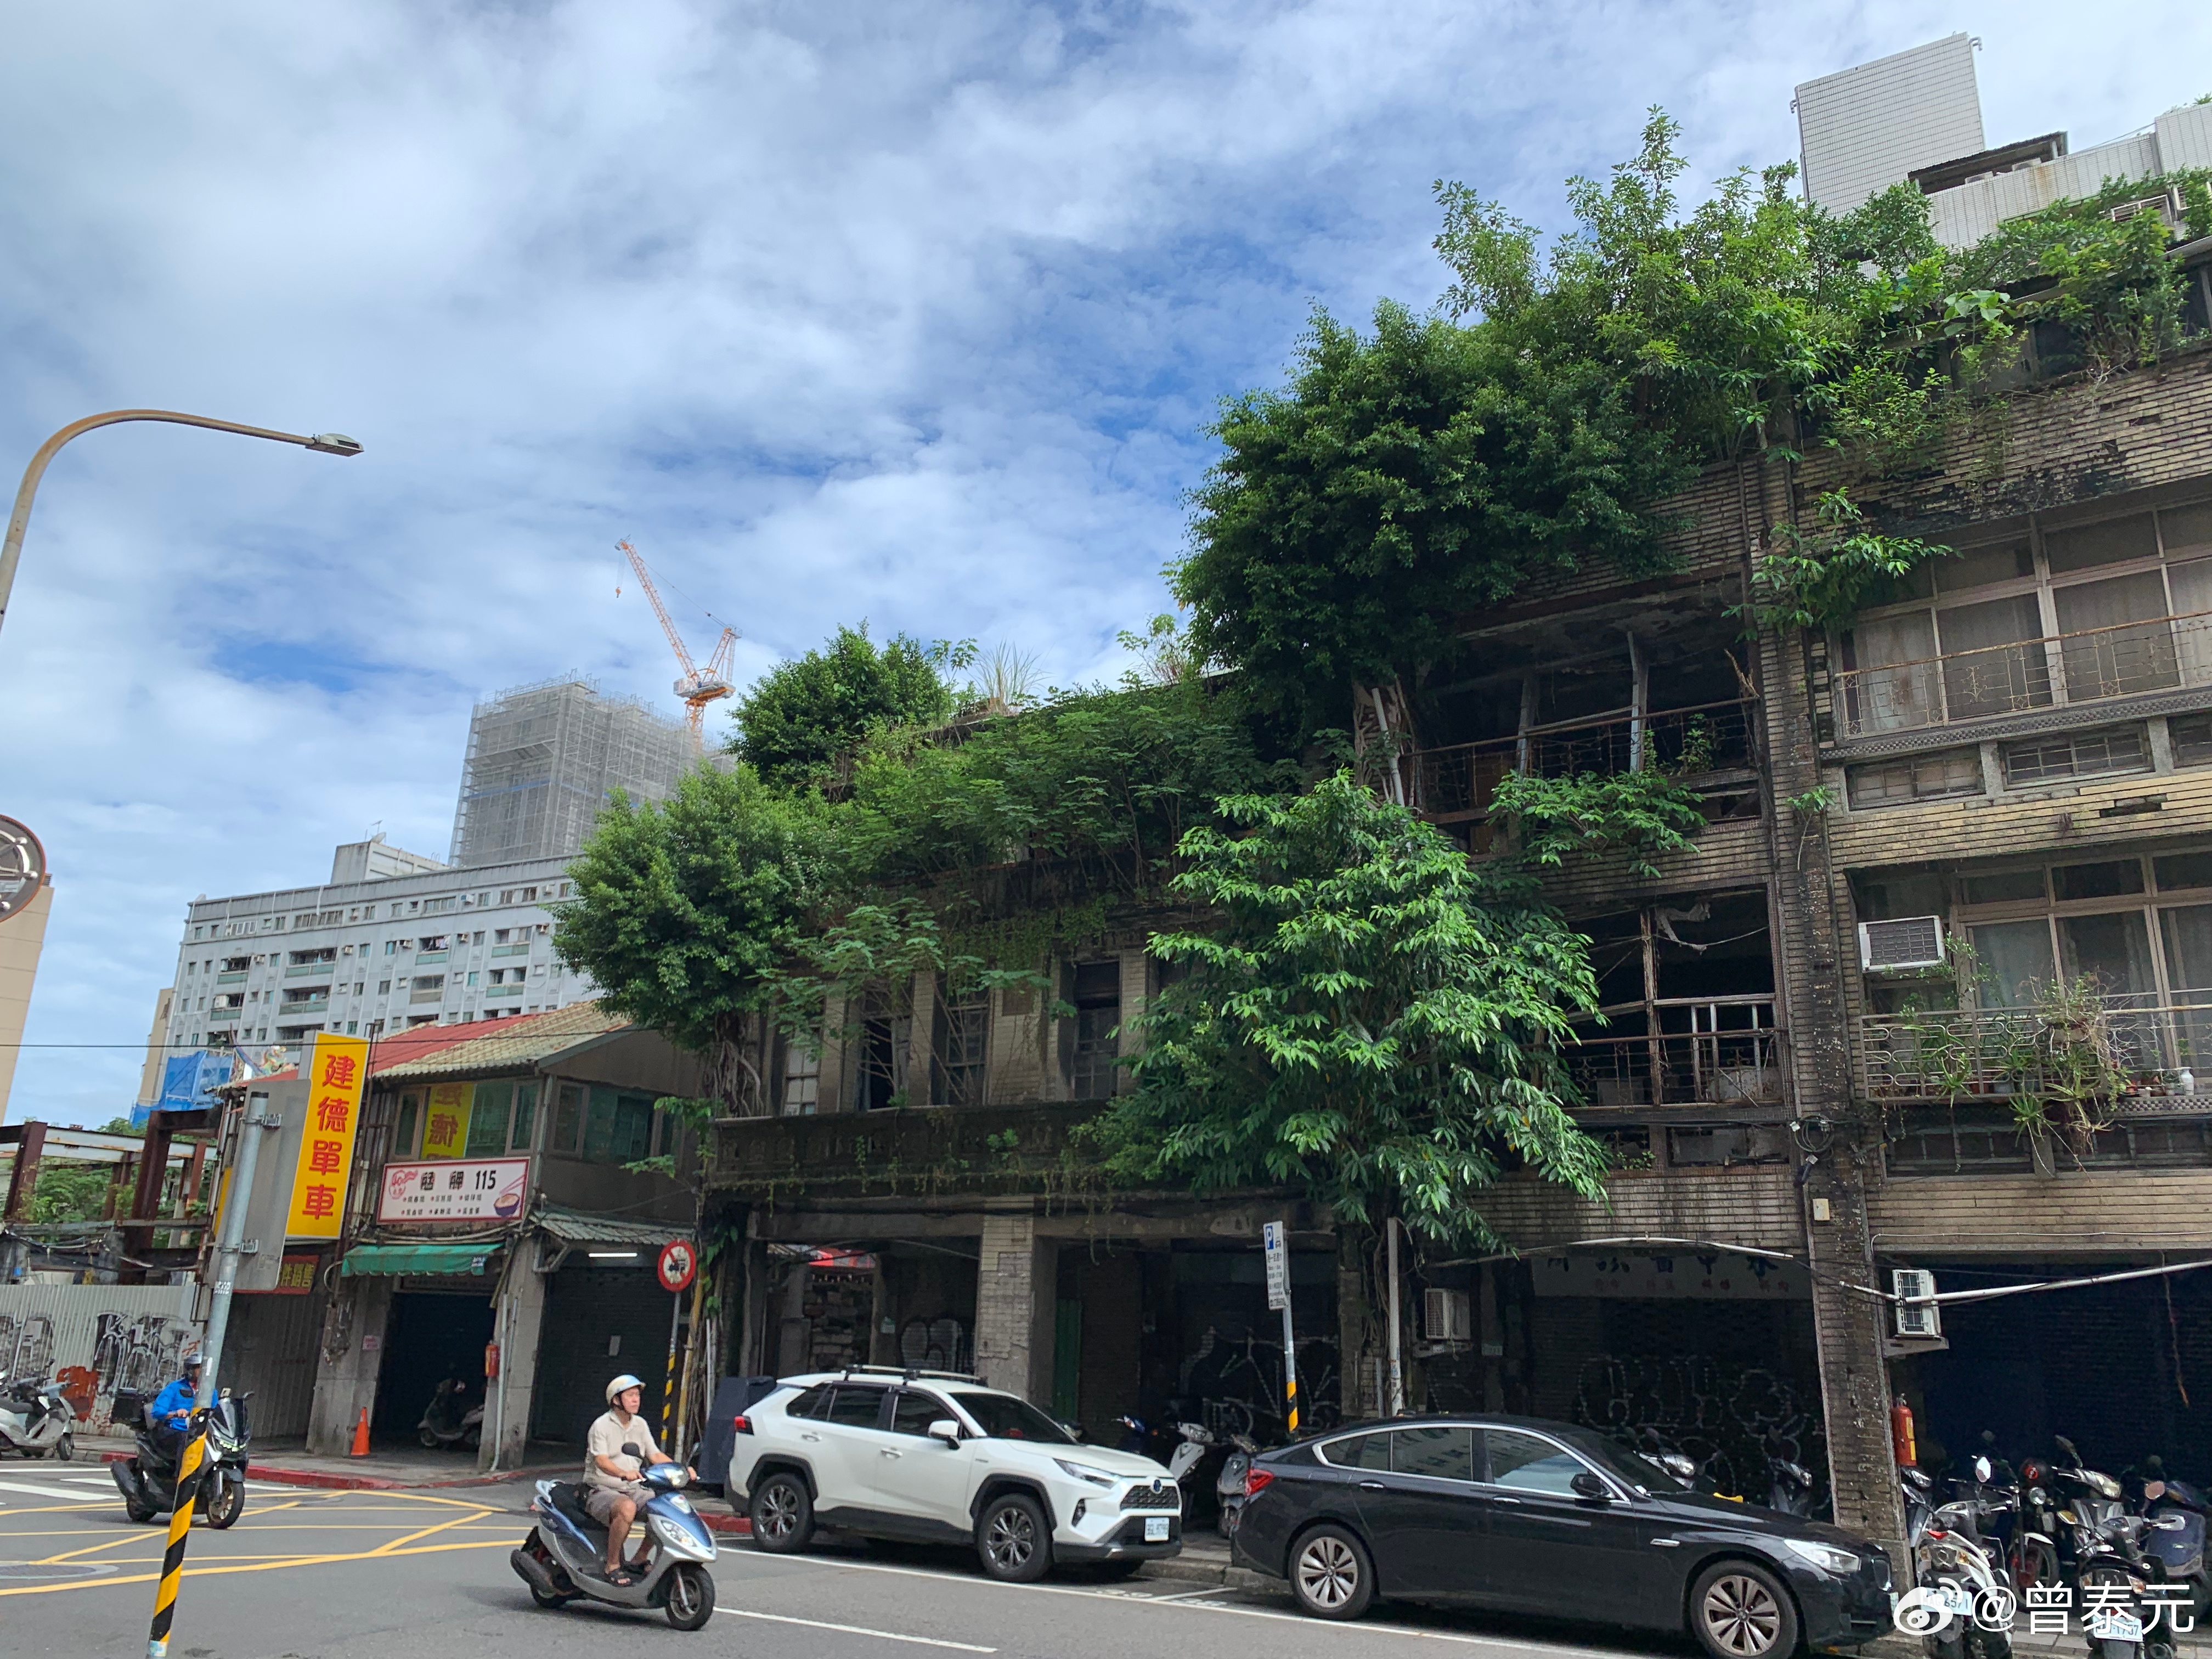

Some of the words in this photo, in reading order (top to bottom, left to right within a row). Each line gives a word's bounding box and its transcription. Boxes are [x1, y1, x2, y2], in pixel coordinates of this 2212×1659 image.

[302, 1053, 356, 1220] 建德單車
[475, 1170, 496, 1190] 115
[1266, 1227, 1273, 1249] P
